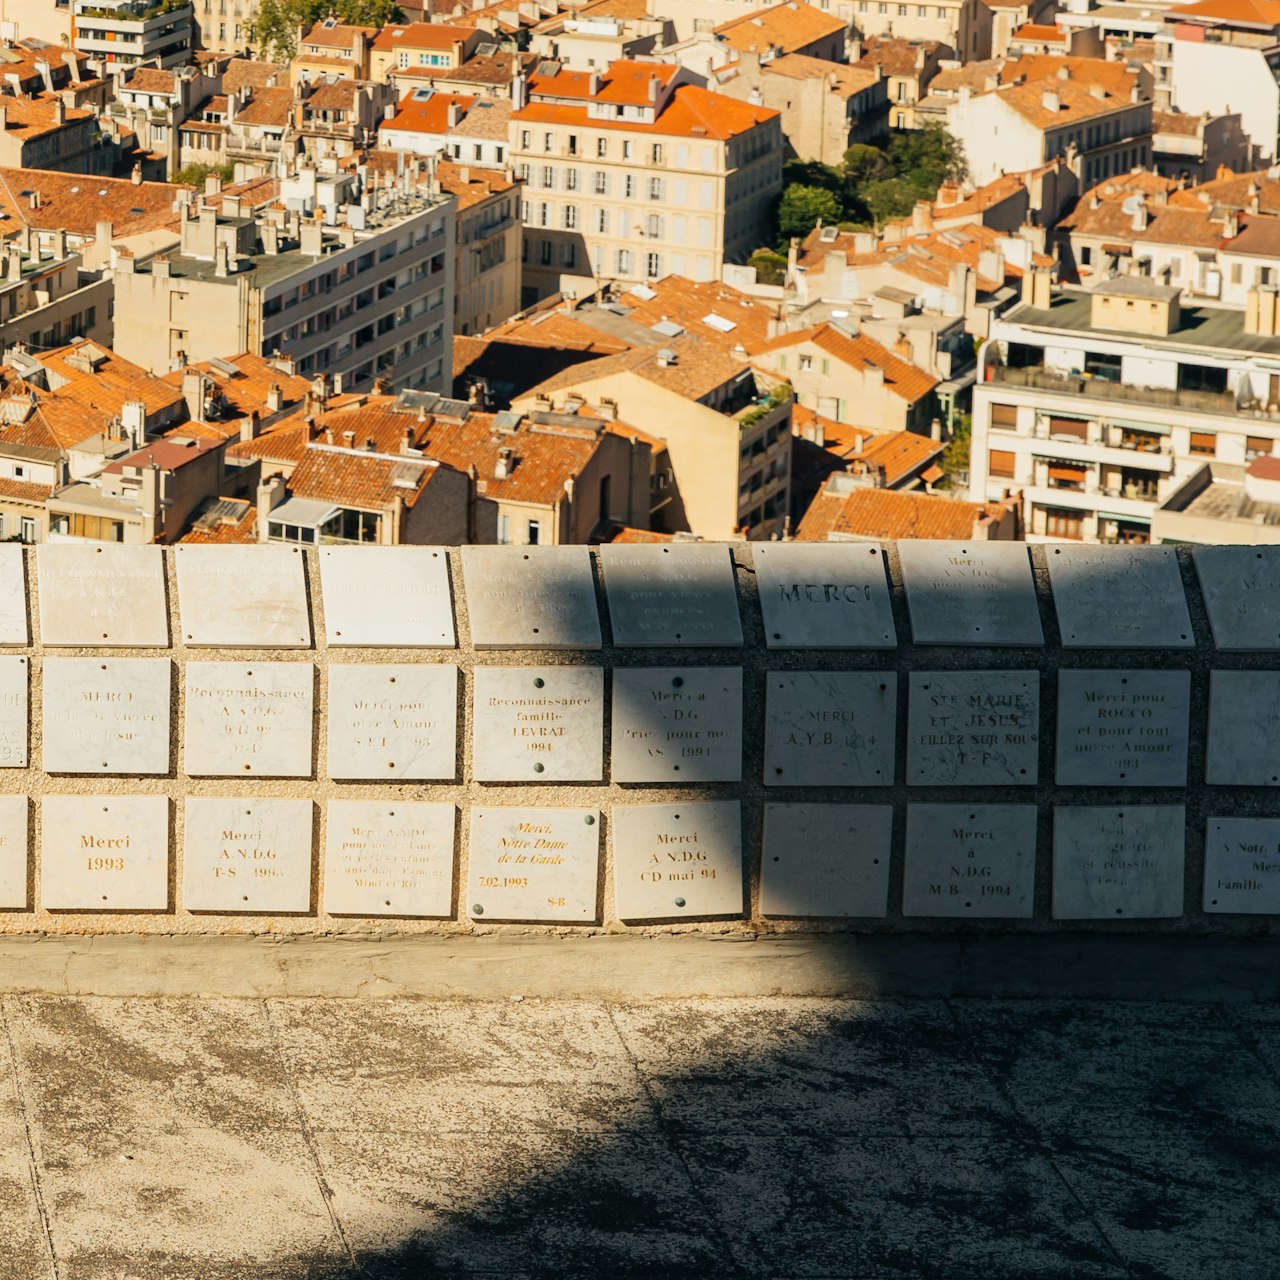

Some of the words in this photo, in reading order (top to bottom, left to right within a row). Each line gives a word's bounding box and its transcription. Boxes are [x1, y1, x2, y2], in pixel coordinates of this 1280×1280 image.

[221, 831, 262, 841] Merci
[657, 833, 699, 844] Merci
[952, 829, 994, 841] Merci
[81, 836, 130, 848] Merci
[533, 838, 568, 850] Dame
[87, 858, 125, 870] 1993
[498, 854, 513, 865] de
[517, 854, 528, 865] la
[531, 854, 566, 865] Garde
